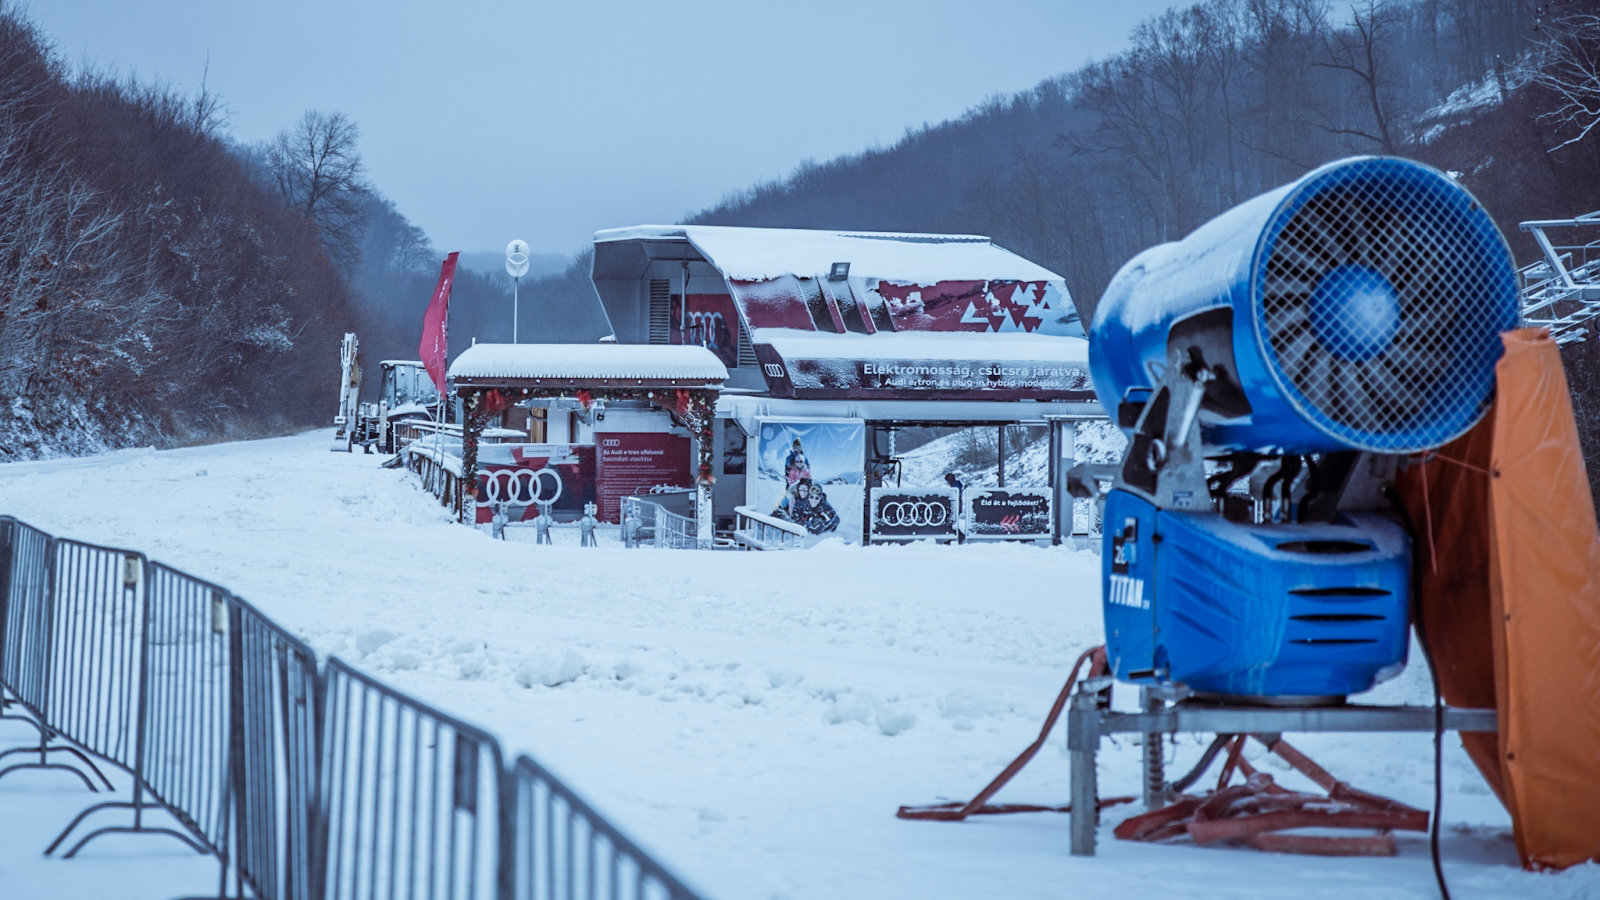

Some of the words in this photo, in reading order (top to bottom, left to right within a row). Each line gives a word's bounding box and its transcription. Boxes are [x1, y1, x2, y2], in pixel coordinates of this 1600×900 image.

[863, 363, 974, 378] Elektromosság,
[979, 364, 1029, 376] csúcsra
[1032, 364, 1084, 378] járatva.
[885, 378, 906, 386] Audi
[986, 378, 1016, 388] hybrid
[981, 498, 992, 506] Éld
[1008, 499, 1039, 507] fejlődést!
[1109, 574, 1144, 608] TITAN
